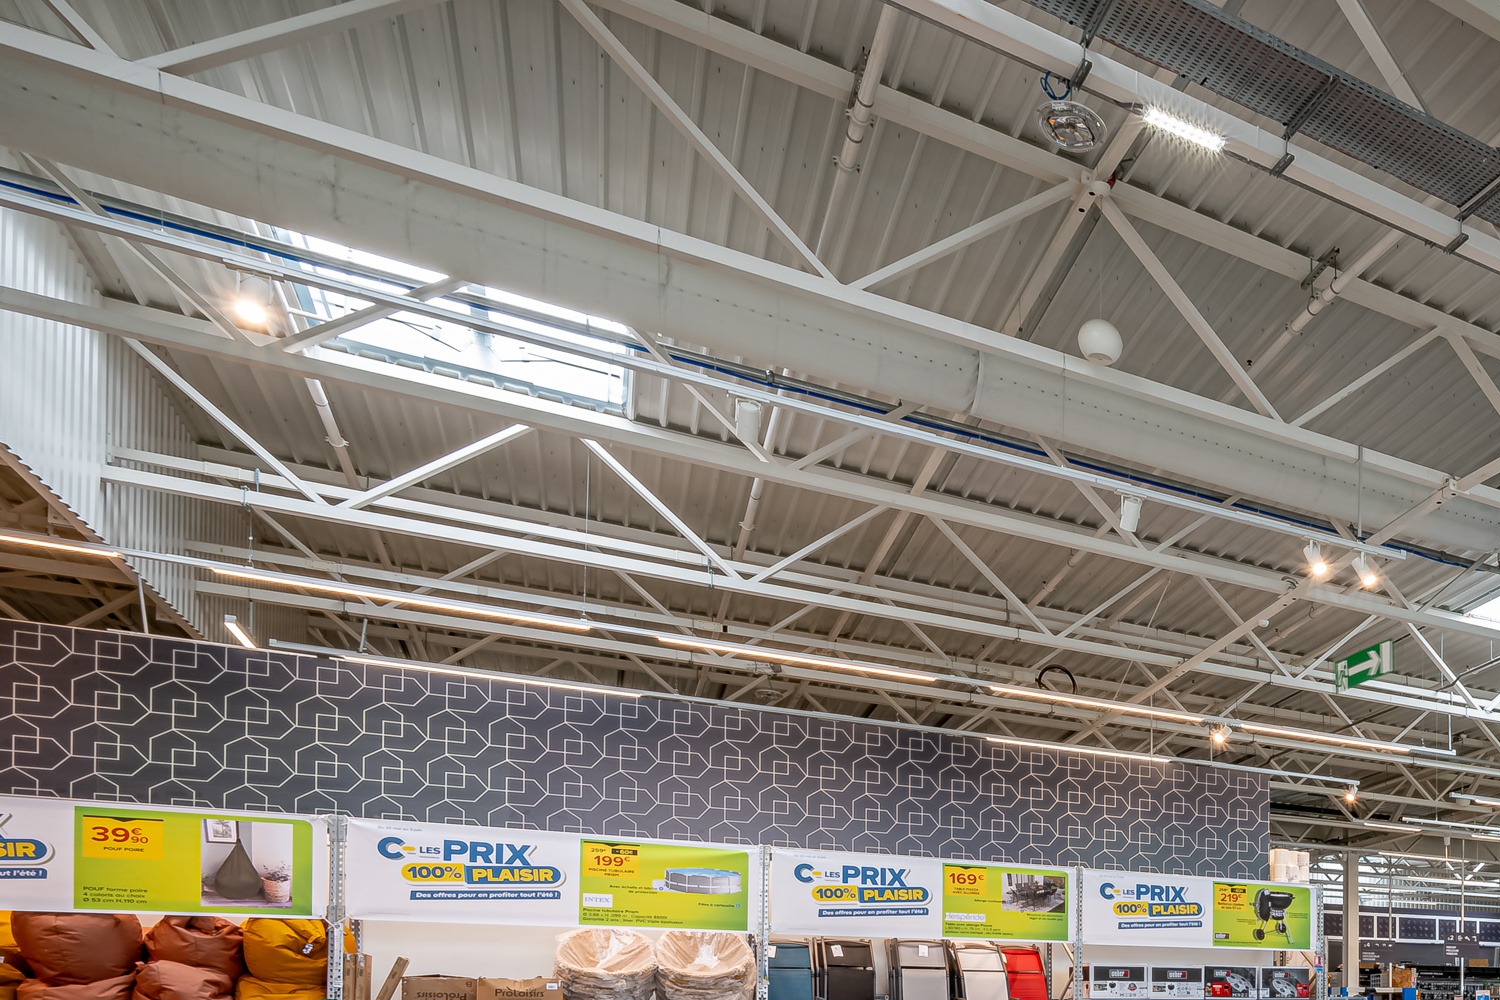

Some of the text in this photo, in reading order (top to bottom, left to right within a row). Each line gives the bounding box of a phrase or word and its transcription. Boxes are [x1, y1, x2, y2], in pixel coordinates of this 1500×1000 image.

[419, 846, 441, 855] LES
[443, 839, 532, 866] PRIX
[407, 865, 554, 882] 100% PLAISIR
[824, 871, 841, 879] LES
[842, 865, 907, 887] PRIX
[949, 872, 984, 885] 169€
[490, 891, 519, 899] profiter
[816, 888, 924, 901] 100% PLAISIR
[1136, 883, 1186, 903] PRIX
[1116, 903, 1198, 915] 100% PLAISIR
